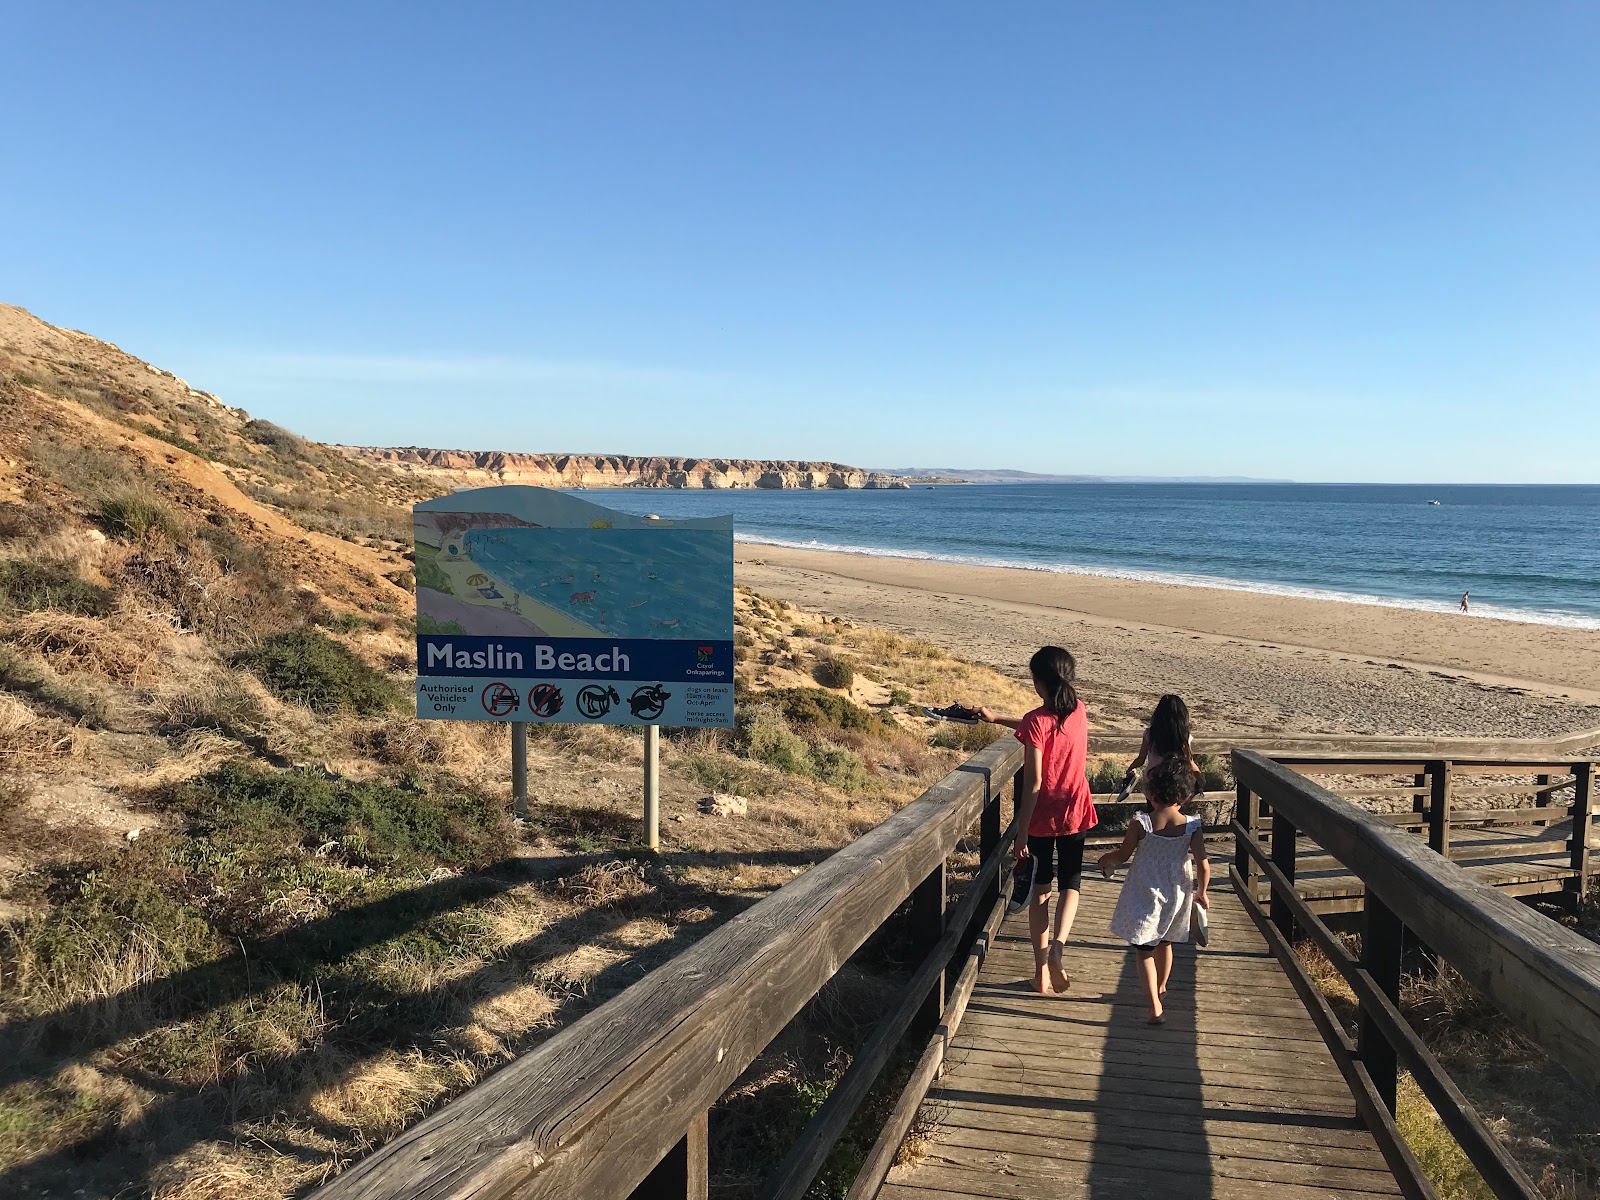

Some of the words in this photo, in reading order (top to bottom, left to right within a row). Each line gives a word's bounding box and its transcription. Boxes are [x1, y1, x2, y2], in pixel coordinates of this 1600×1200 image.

[427, 643, 523, 670] Maslin
[536, 645, 630, 672] Beach
[420, 684, 474, 692] Authorised
[428, 694, 467, 702] Vehicles
[434, 703, 456, 714] Only
